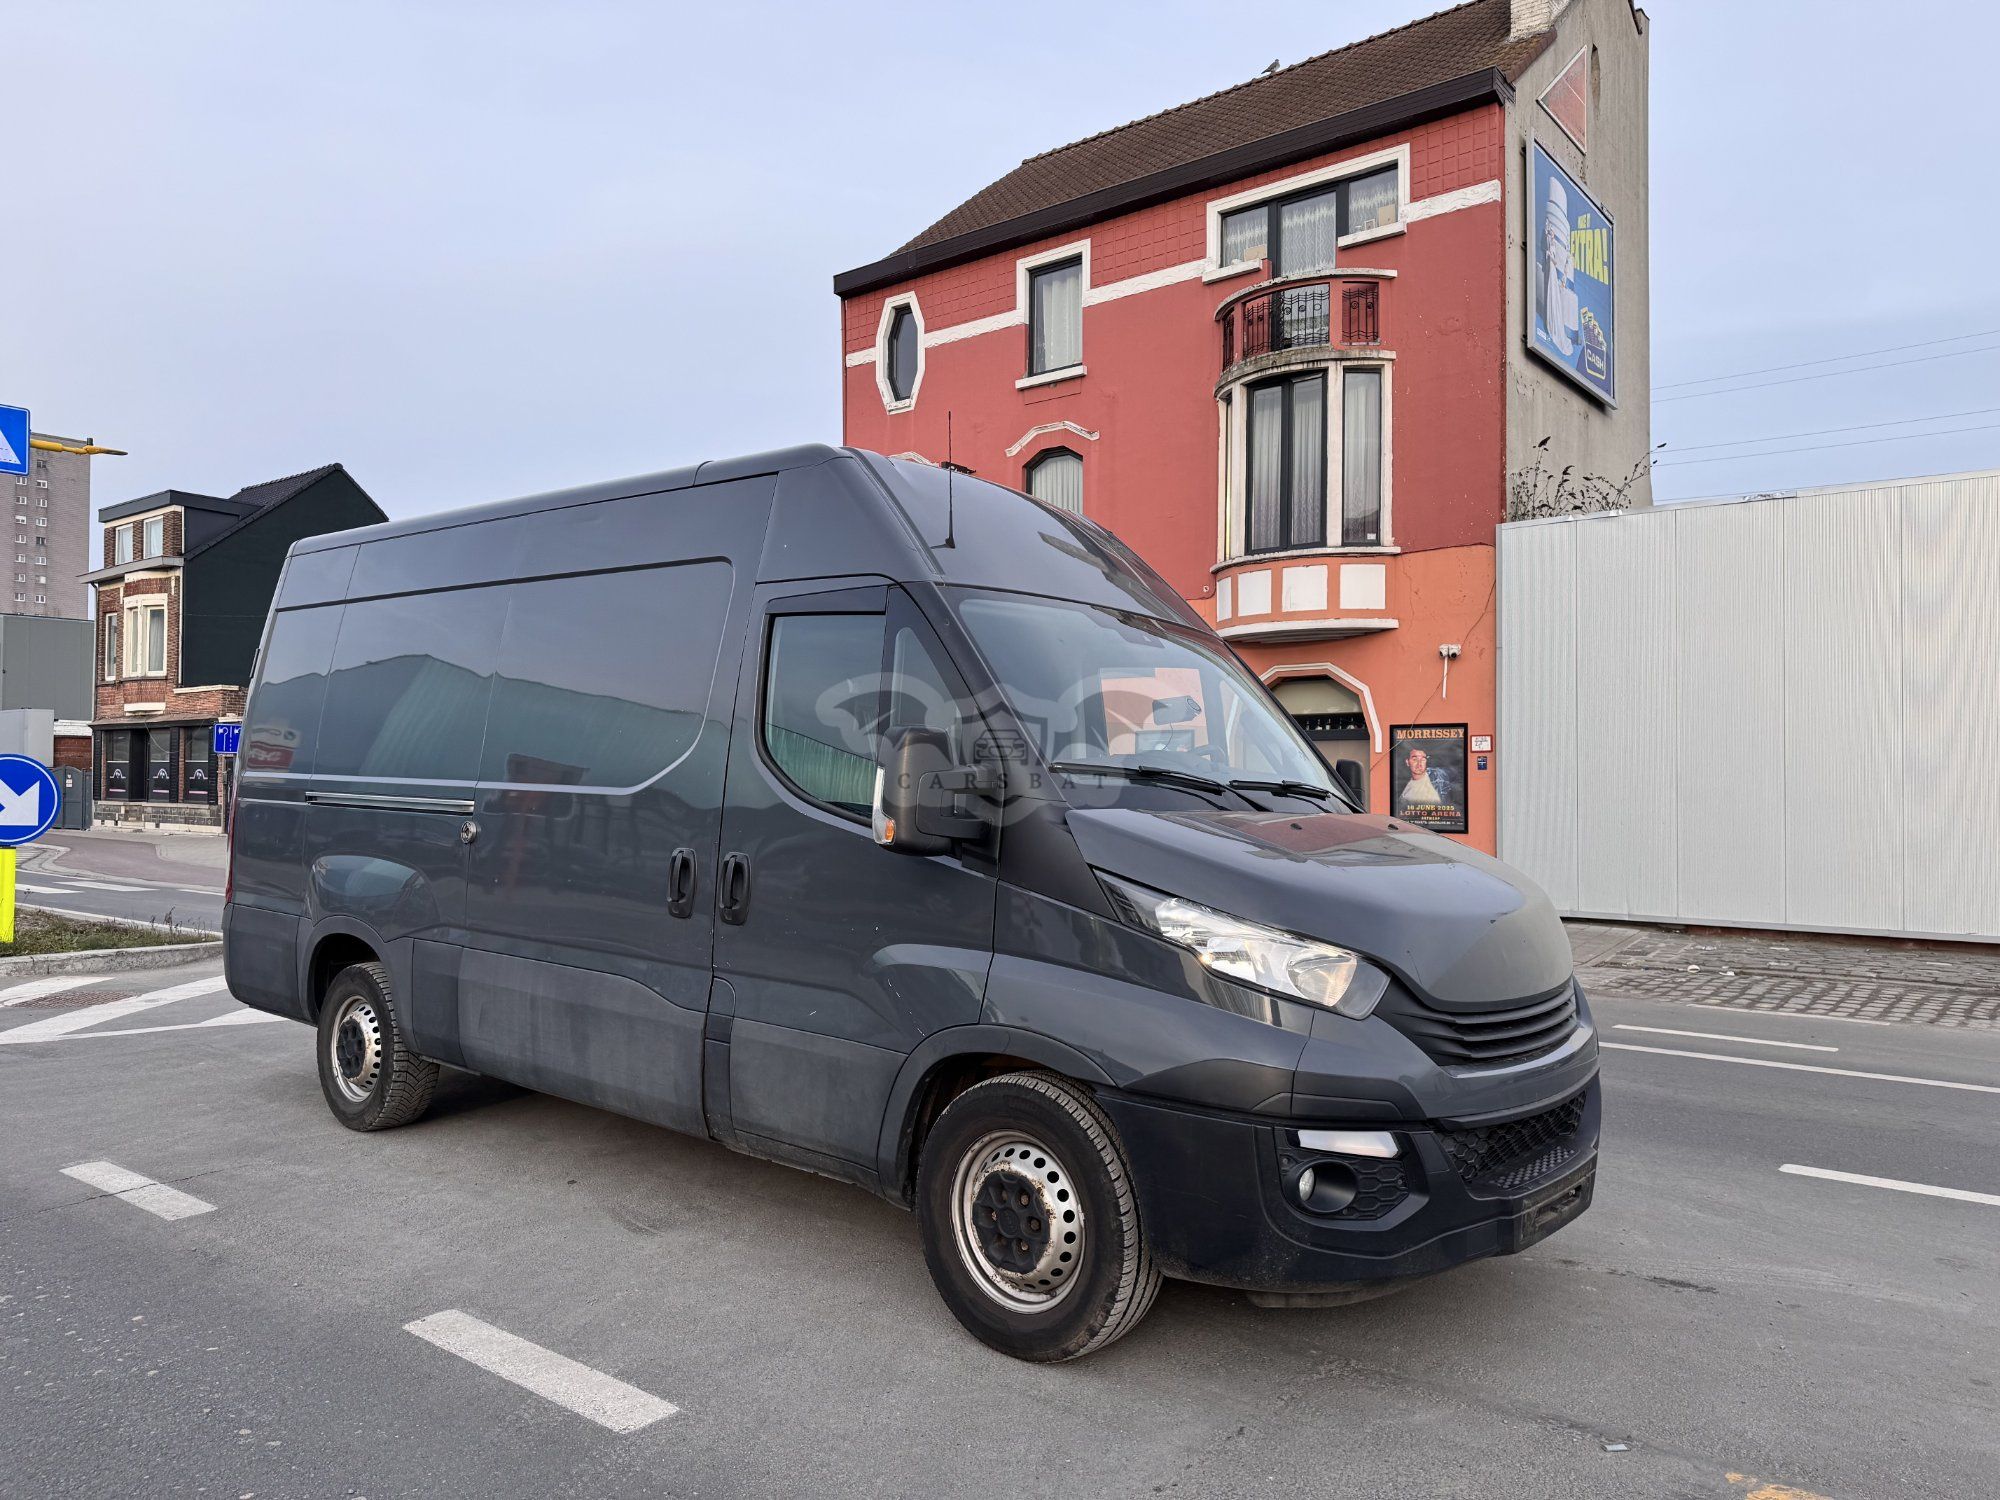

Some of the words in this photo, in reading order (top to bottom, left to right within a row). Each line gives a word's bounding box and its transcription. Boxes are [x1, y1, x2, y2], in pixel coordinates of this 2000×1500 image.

[1570, 228, 1609, 285] EXTRA!
[1586, 348, 1604, 371] CASH
[1396, 728, 1464, 739] MORRISSEY
